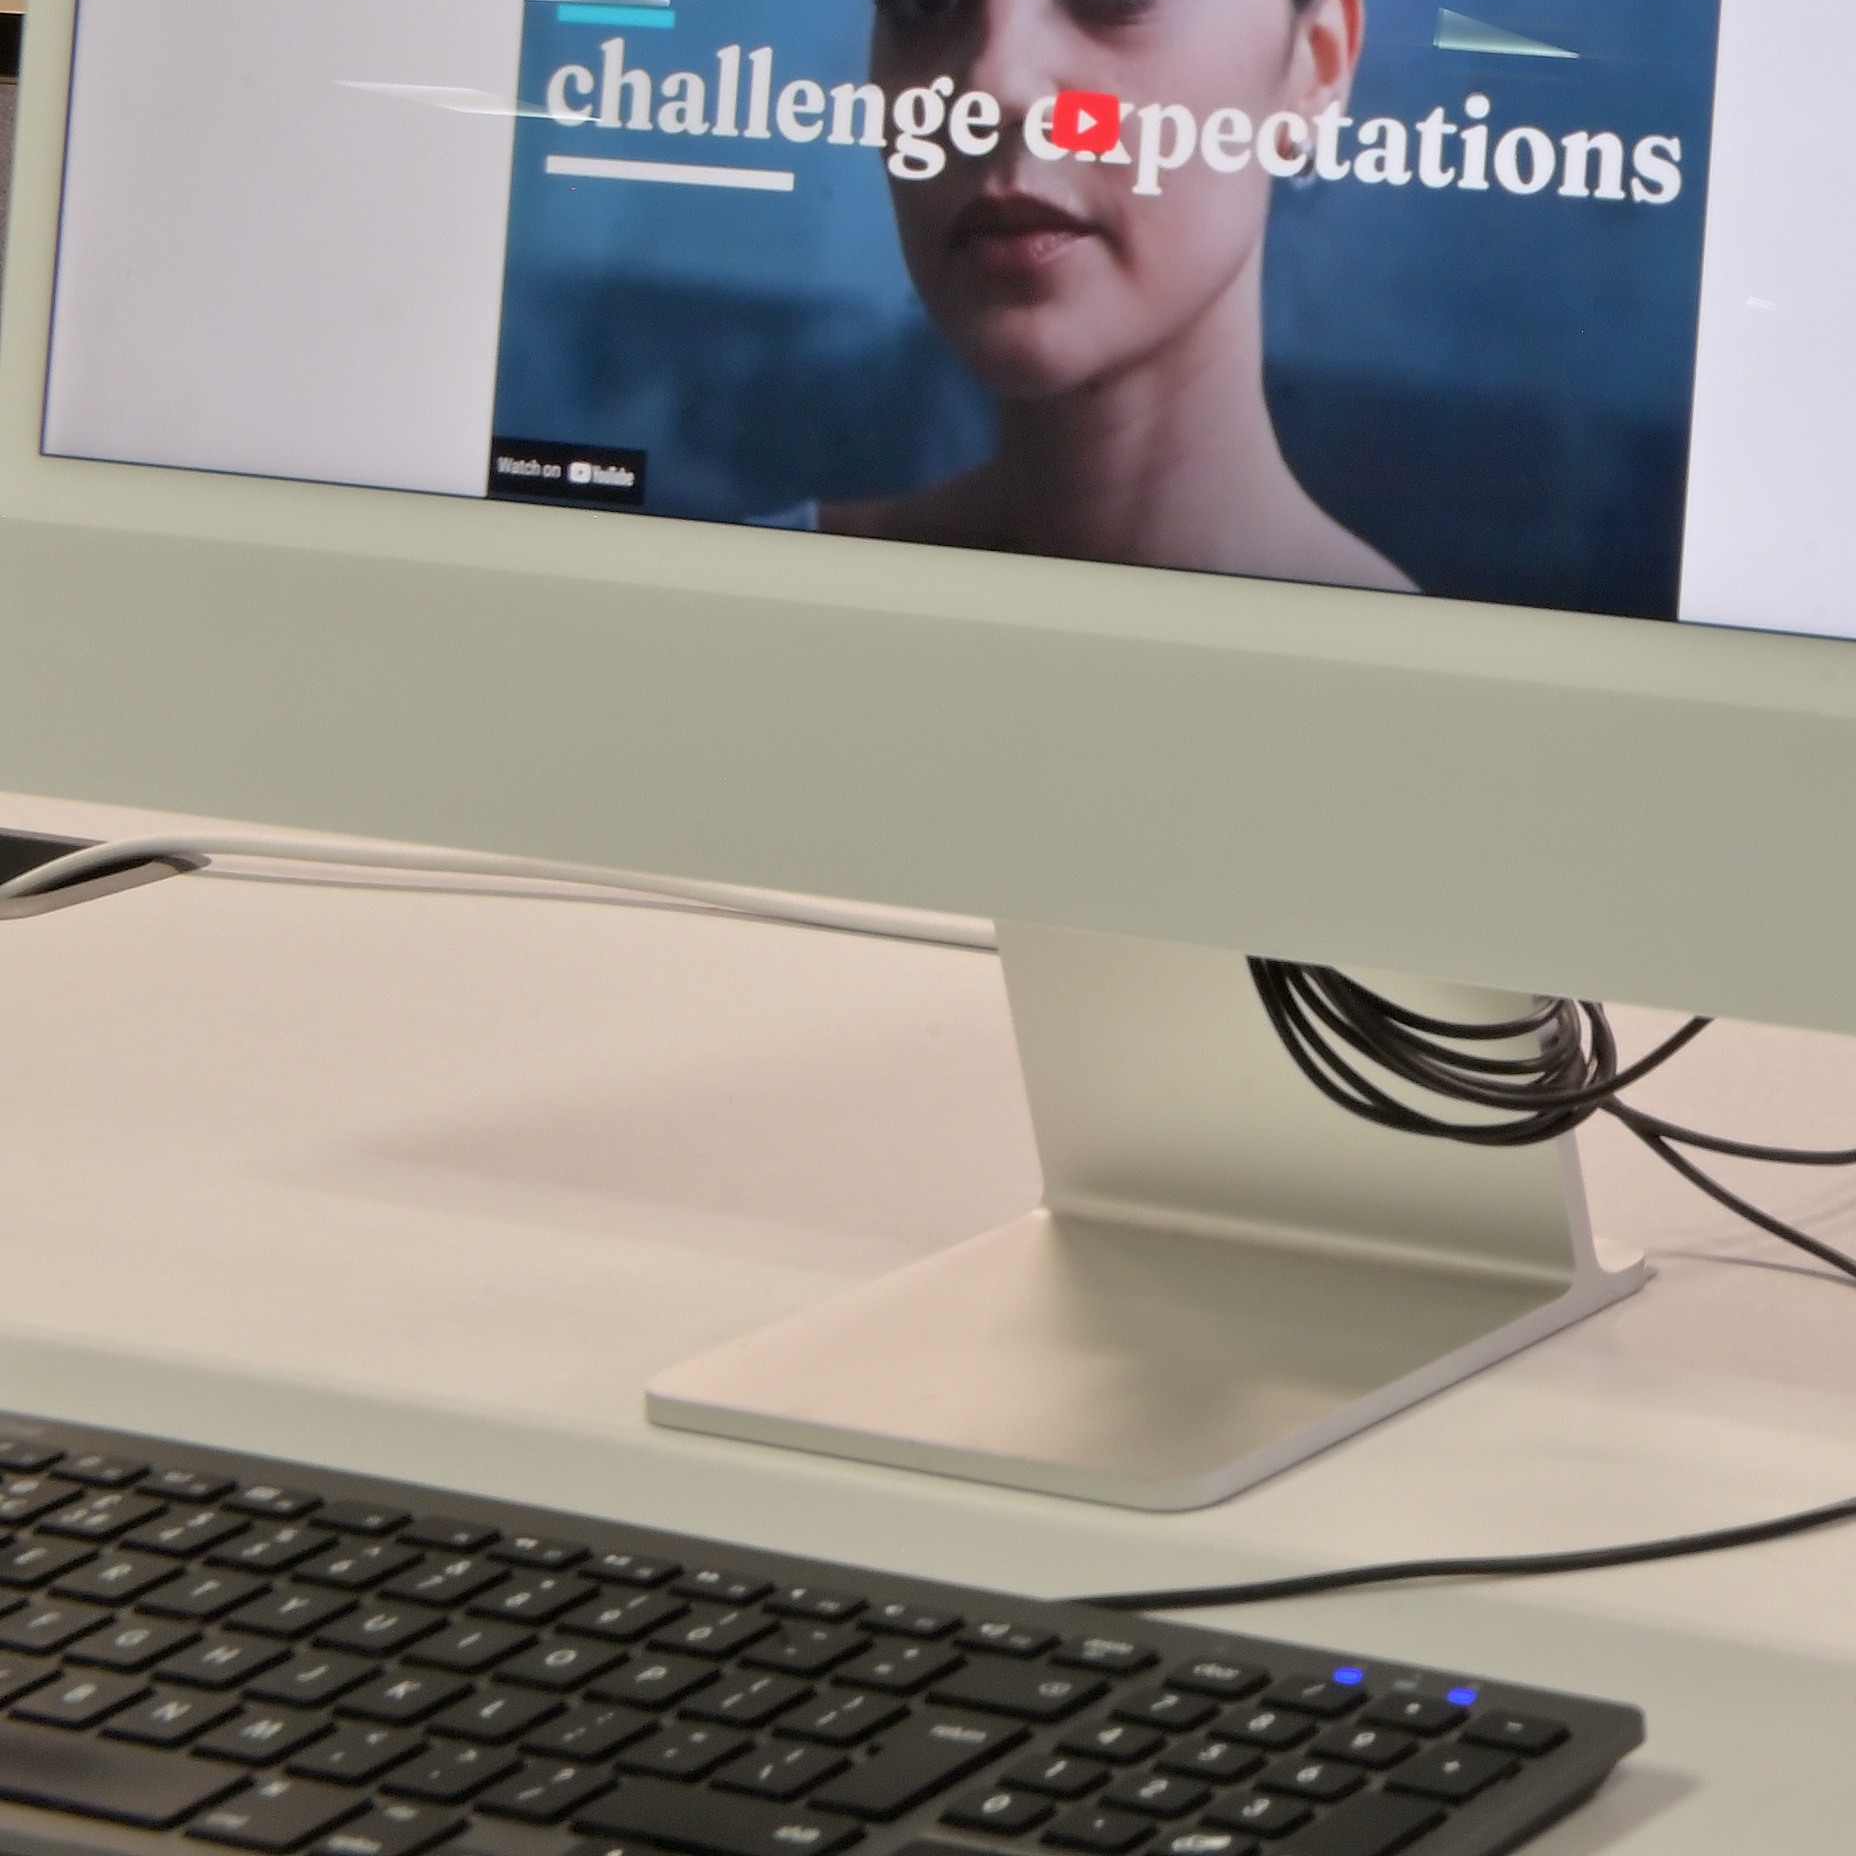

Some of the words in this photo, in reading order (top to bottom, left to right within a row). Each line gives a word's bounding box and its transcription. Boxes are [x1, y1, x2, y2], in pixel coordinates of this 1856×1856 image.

[545, 37, 1000, 180] challenge
[497, 456, 541, 477] Watch
[542, 464, 562, 479] on
